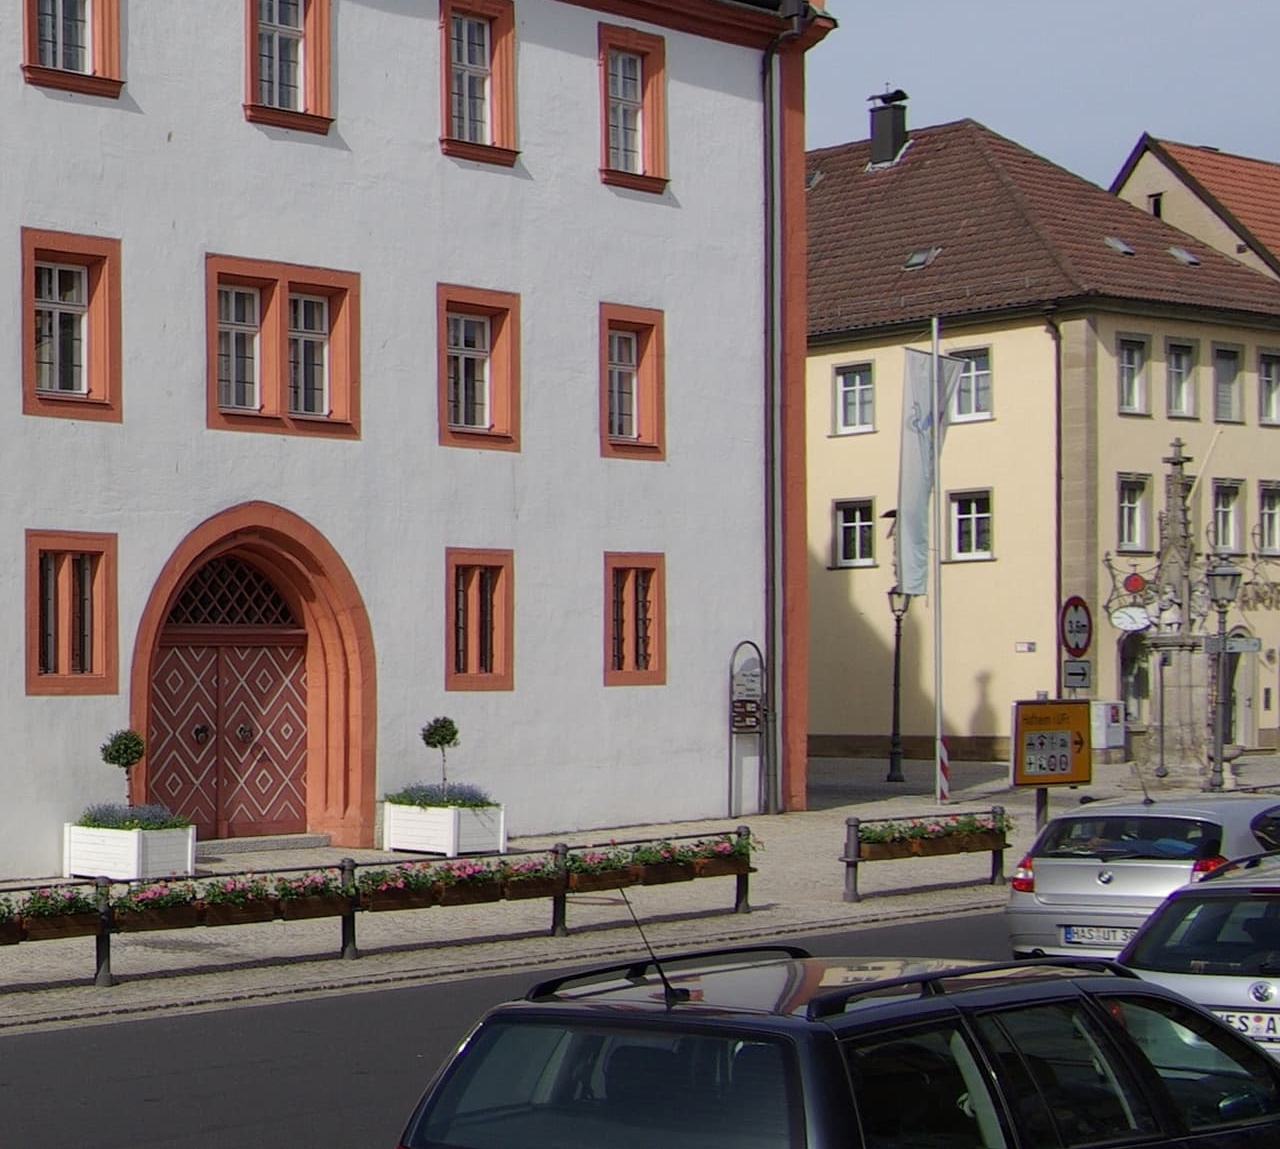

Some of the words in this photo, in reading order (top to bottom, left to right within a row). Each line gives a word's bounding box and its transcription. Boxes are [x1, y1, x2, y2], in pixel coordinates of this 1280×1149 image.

[1072, 928, 1094, 941] HAS
[1103, 930, 1117, 941] UT
[1219, 1014, 1249, 1032] ES
